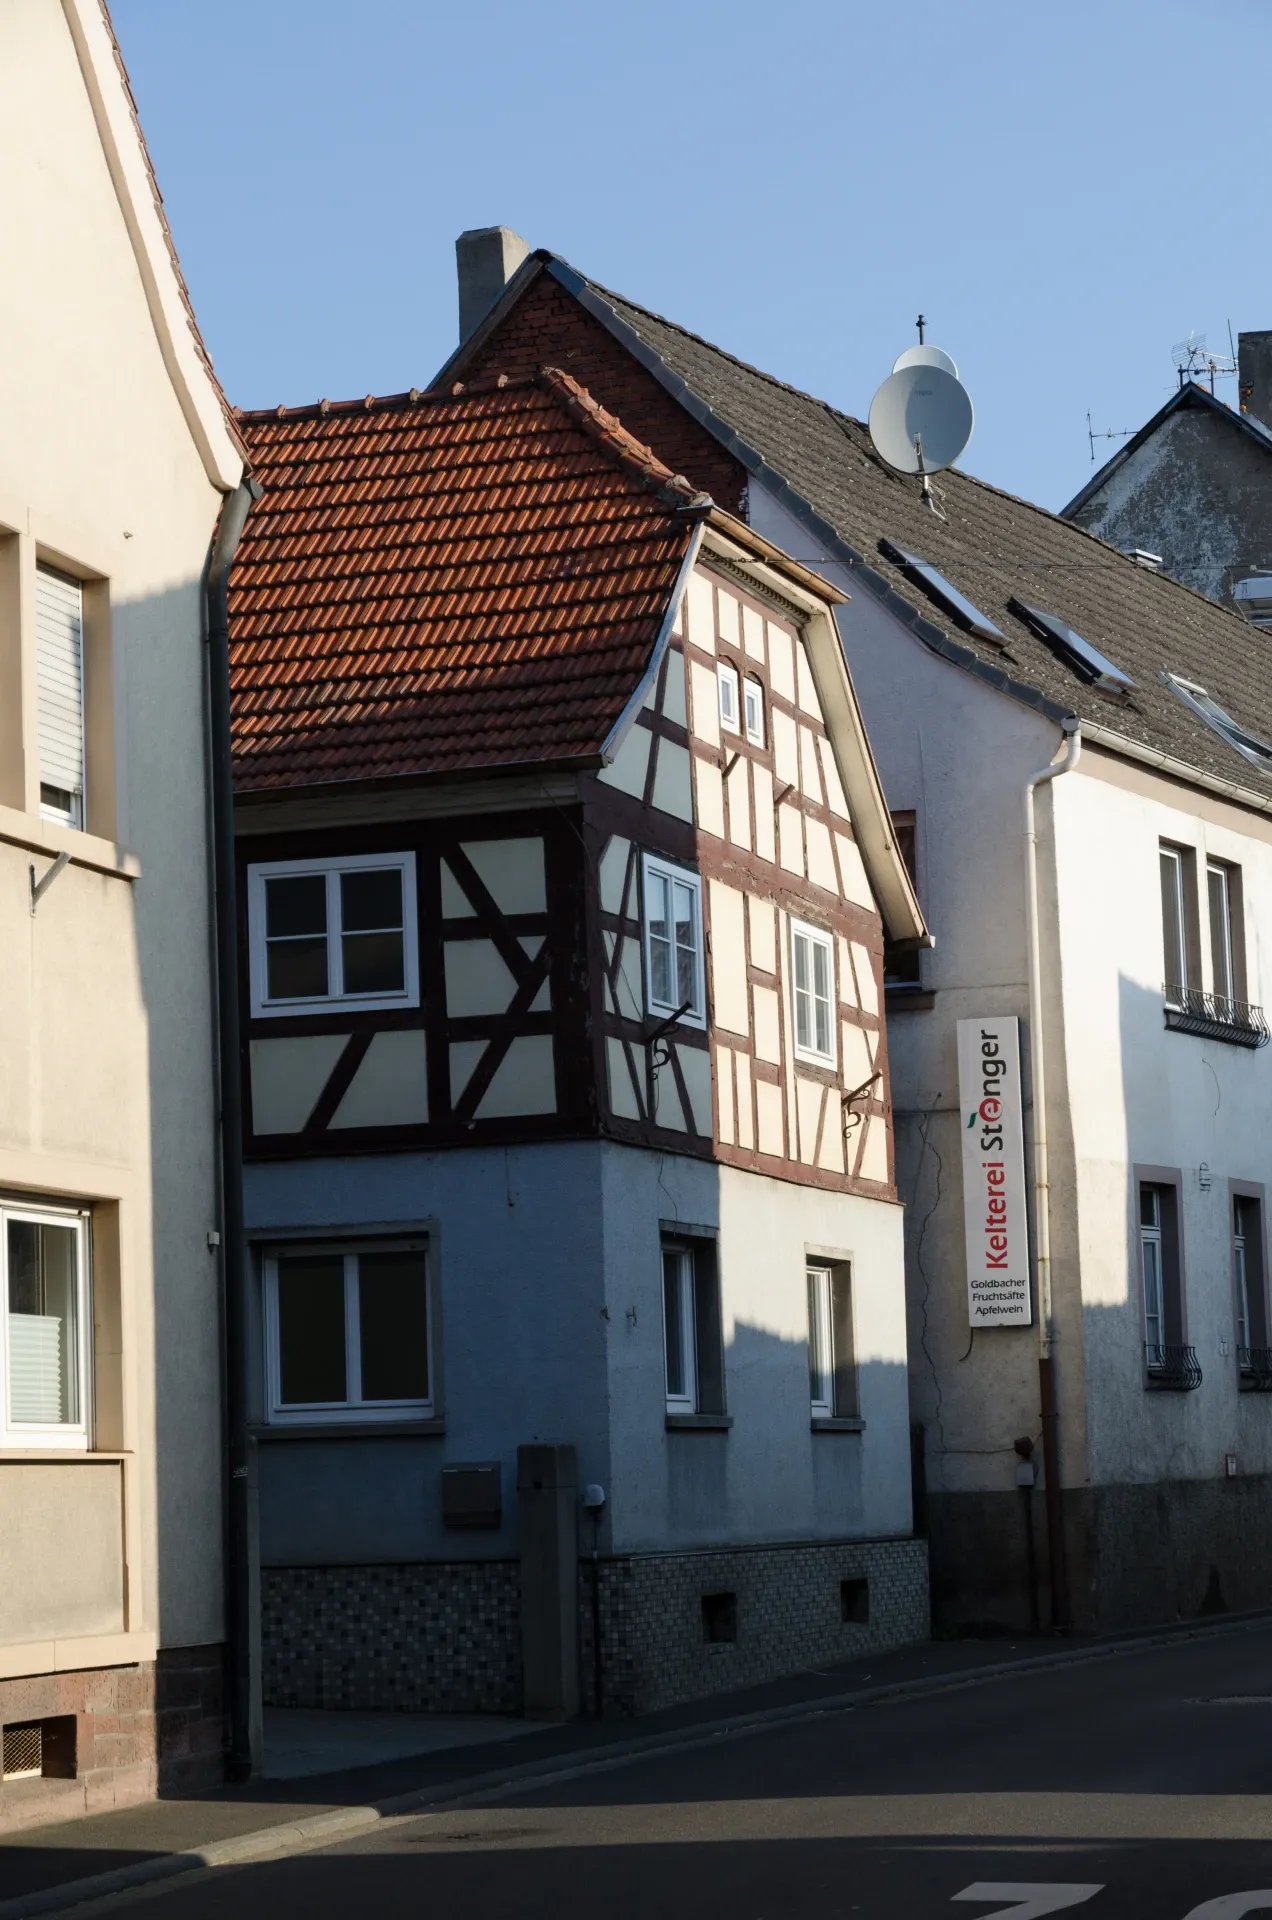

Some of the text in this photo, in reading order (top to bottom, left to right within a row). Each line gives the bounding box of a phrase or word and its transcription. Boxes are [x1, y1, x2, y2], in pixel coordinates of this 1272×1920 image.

[979, 1029, 1008, 1269] Kelterei Stenger
[970, 1279, 1026, 1290] Goldbacher
[972, 1291, 1025, 1302] Fruchtsäfte
[974, 1305, 1024, 1317] Apfelwein
